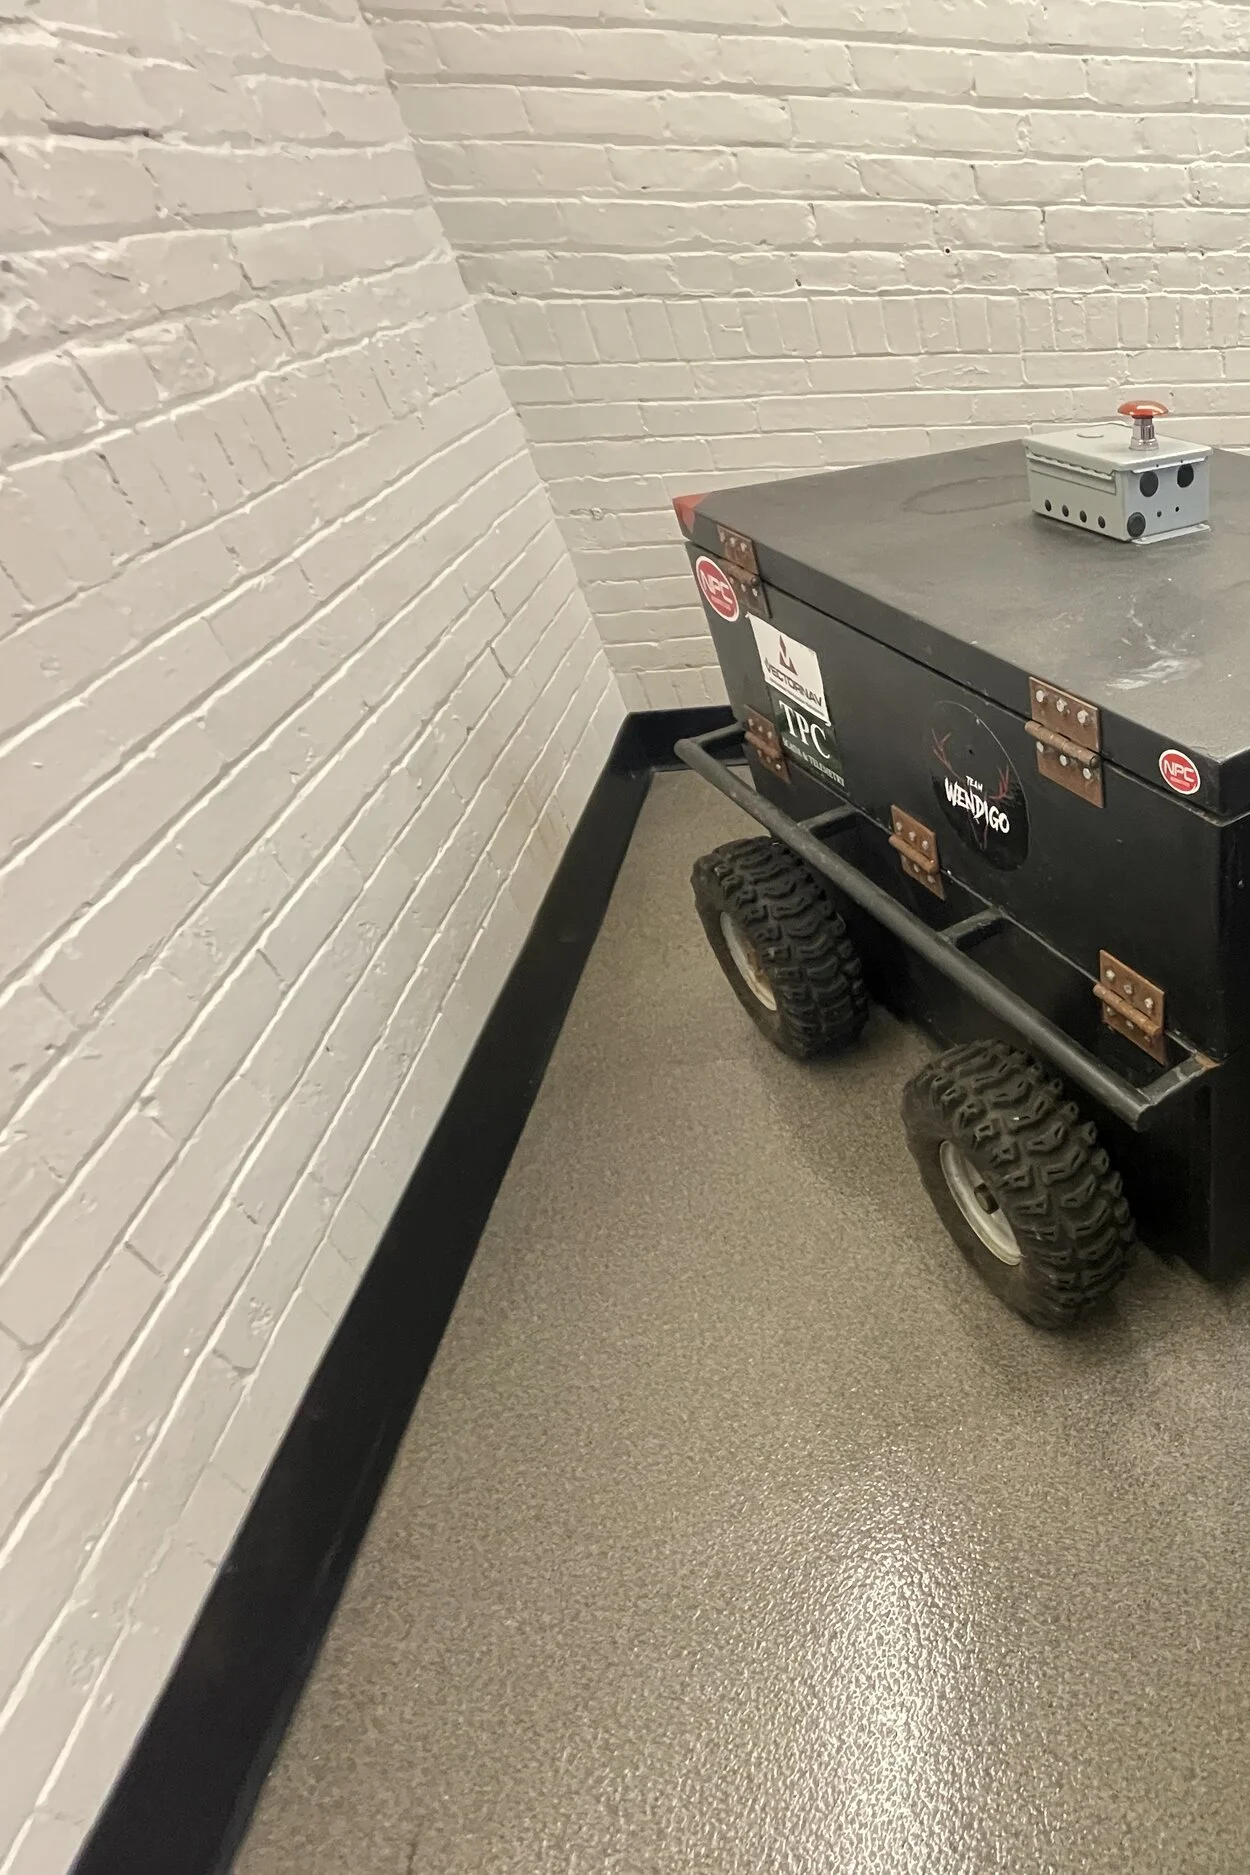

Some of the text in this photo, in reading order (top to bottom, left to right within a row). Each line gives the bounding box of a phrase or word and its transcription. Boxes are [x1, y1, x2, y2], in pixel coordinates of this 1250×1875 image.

[700, 569, 733, 604] NPC
[778, 699, 831, 760] TPC
[1163, 758, 1195, 783] NPC
[944, 776, 1010, 834] WENDIGO
